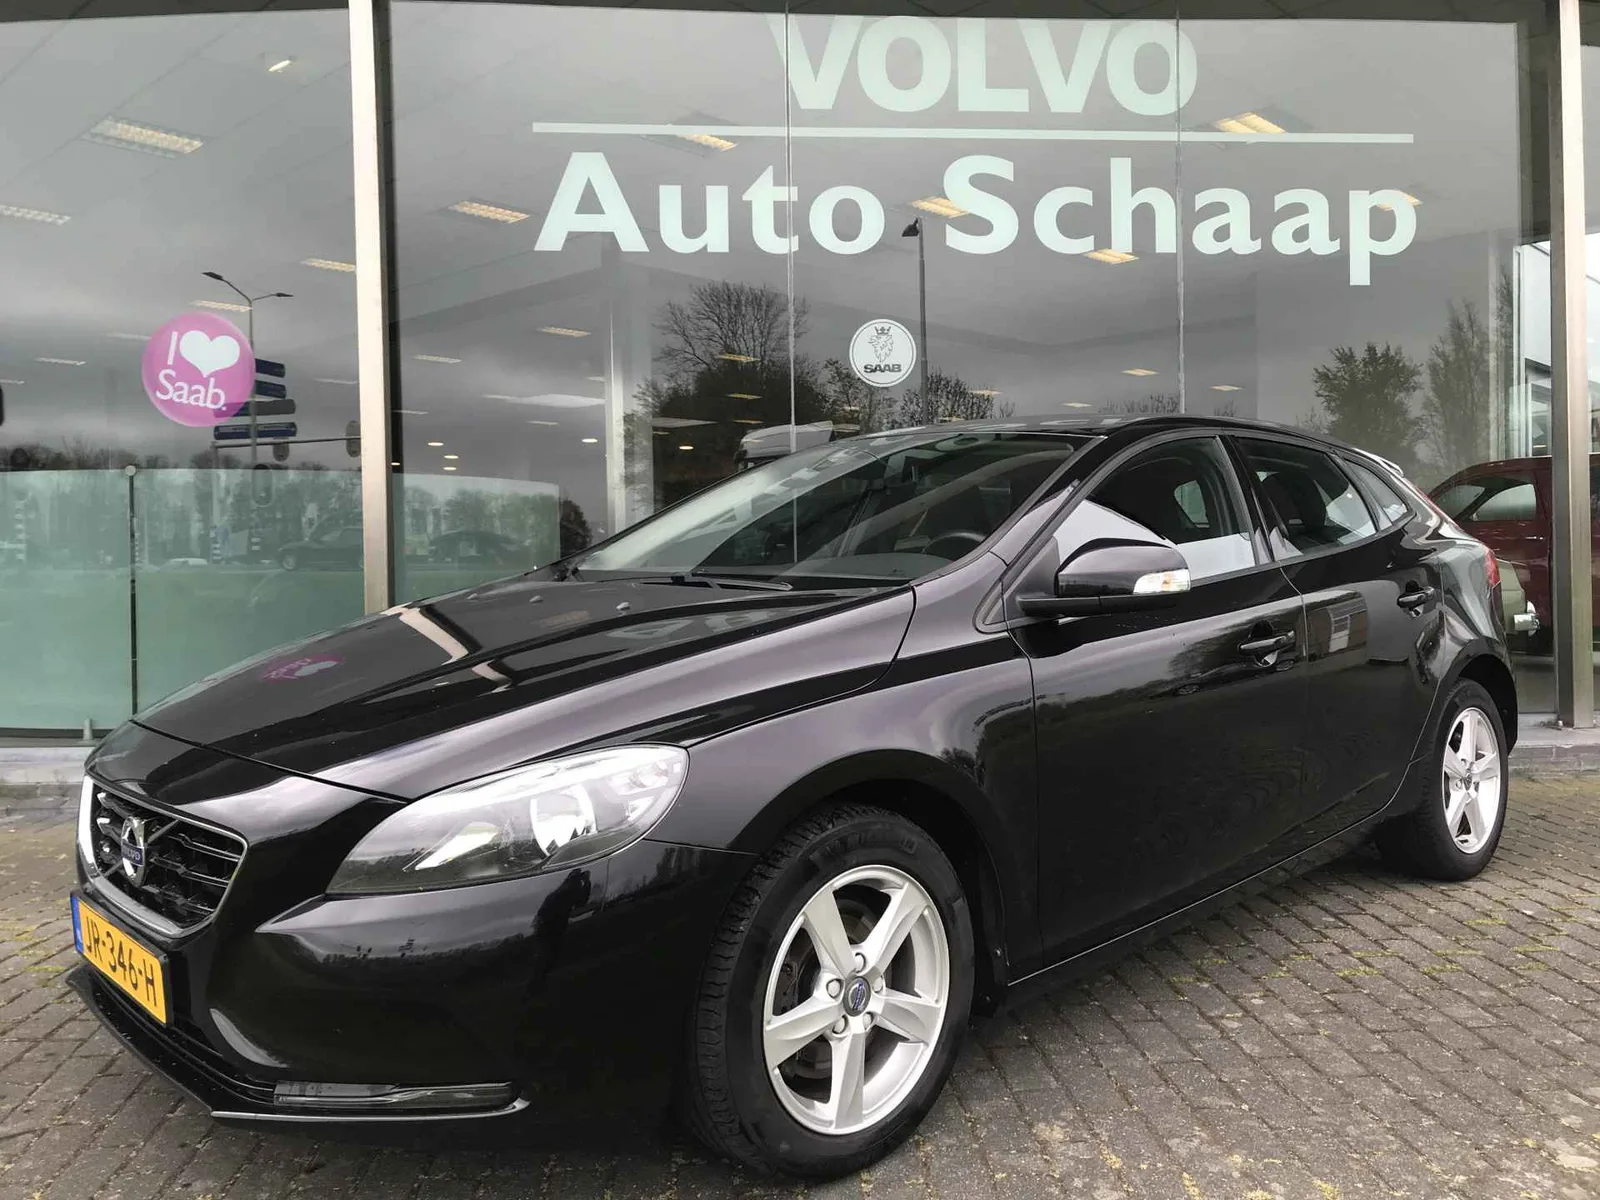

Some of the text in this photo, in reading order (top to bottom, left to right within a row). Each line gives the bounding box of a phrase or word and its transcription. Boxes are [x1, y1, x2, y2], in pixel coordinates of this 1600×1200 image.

[765, 13, 1198, 116] VOLVO
[533, 151, 1417, 286] Auto Schaap
[863, 363, 902, 374] SAAB
[85, 915, 158, 1008] JR-346-H
